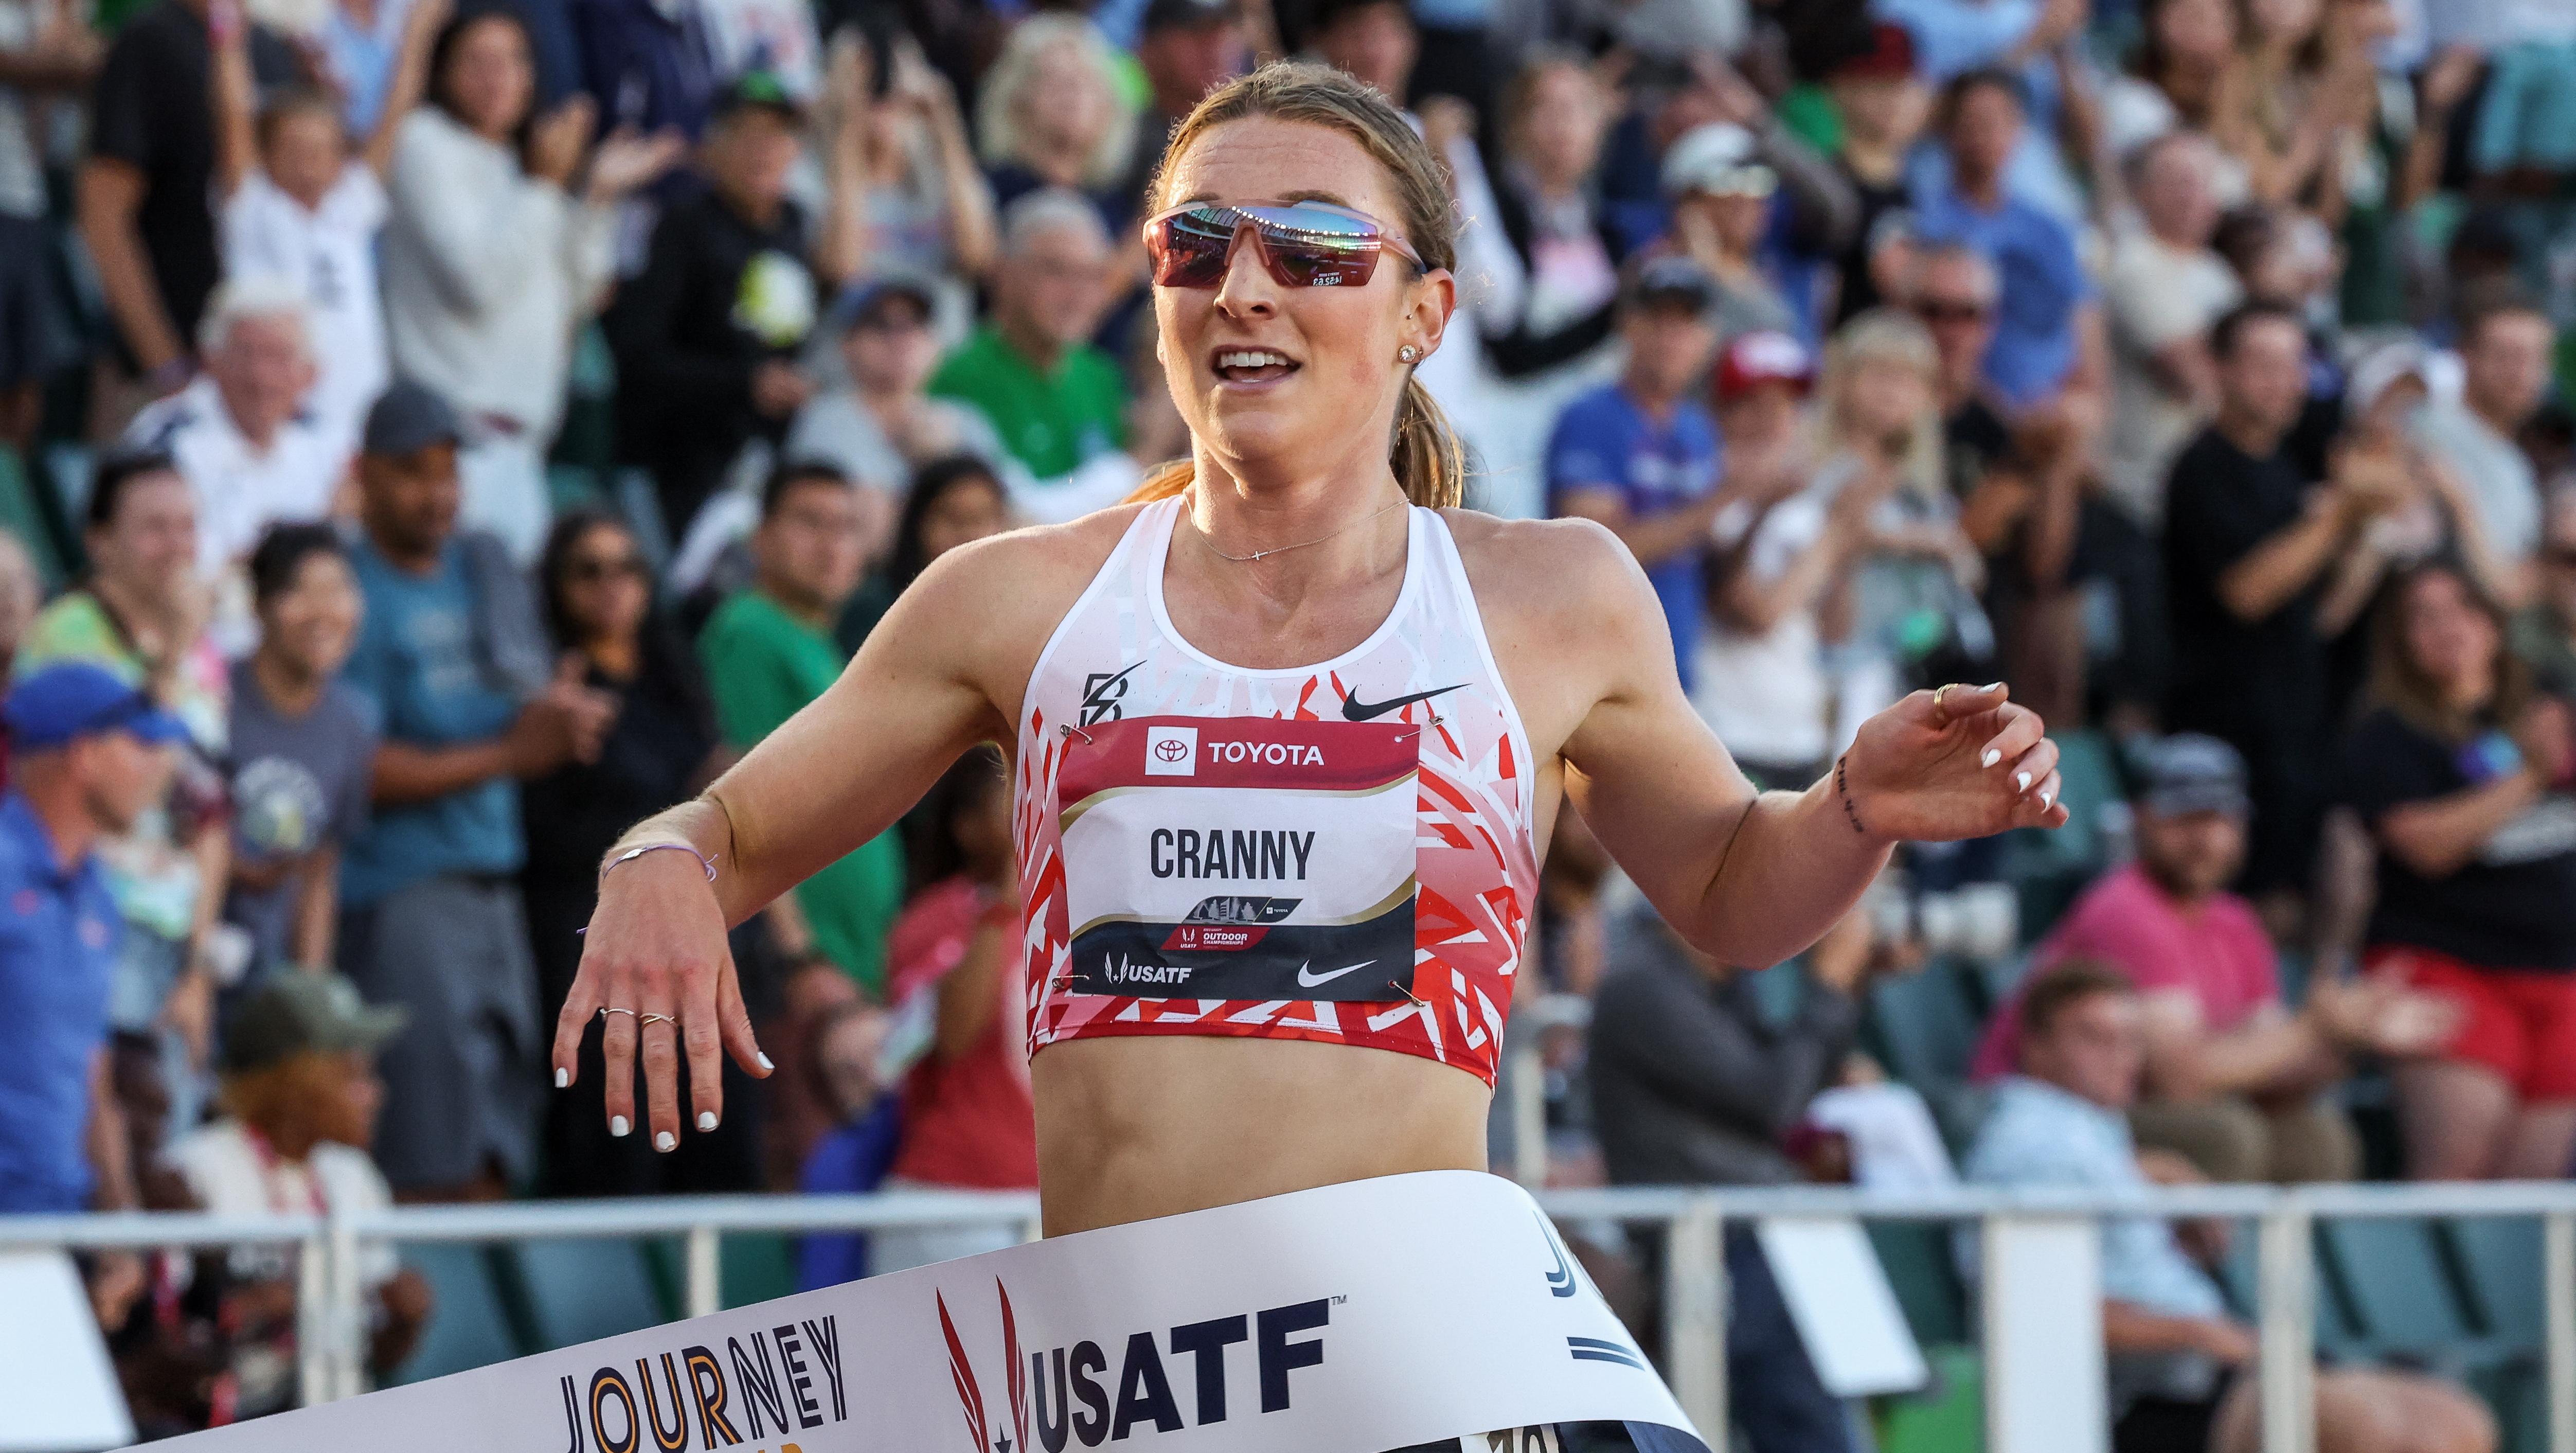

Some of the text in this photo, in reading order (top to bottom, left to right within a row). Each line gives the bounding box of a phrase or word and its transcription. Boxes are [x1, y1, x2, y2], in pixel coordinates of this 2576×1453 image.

[1208, 741, 1325, 766] TOYOTA
[1150, 828, 1315, 880] CRANNY
[1203, 933, 1248, 941] OUTDOOR
[1129, 965, 1192, 984] USATF
[560, 1315, 848, 1453] JOURNEY
[1032, 1298, 1329, 1453] USATF
